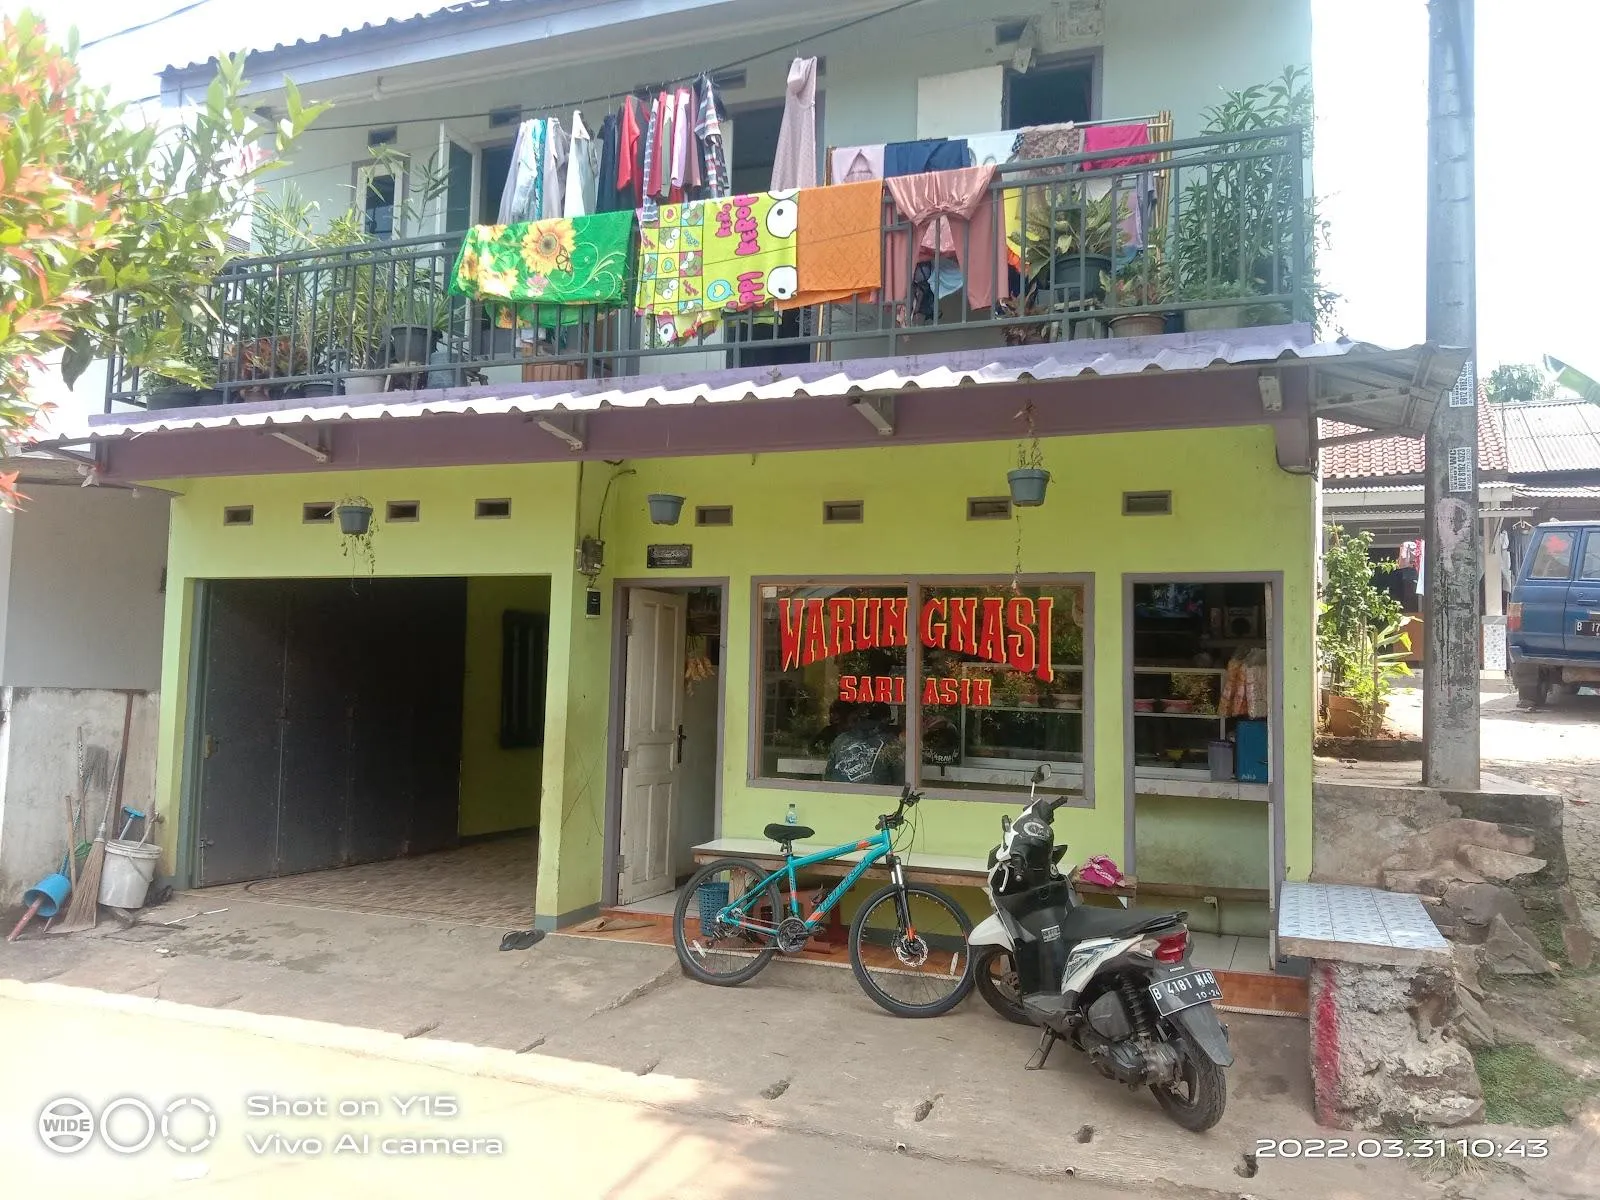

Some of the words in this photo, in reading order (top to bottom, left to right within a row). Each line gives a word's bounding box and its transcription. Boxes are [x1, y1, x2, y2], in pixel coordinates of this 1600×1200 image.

[1576, 621, 1583, 632] B
[839, 675, 905, 703] SARI
[922, 677, 992, 706] ASIH
[1152, 987, 1163, 1001] B
[1166, 977, 1193, 995] 4181
[1194, 971, 1215, 987] NAB
